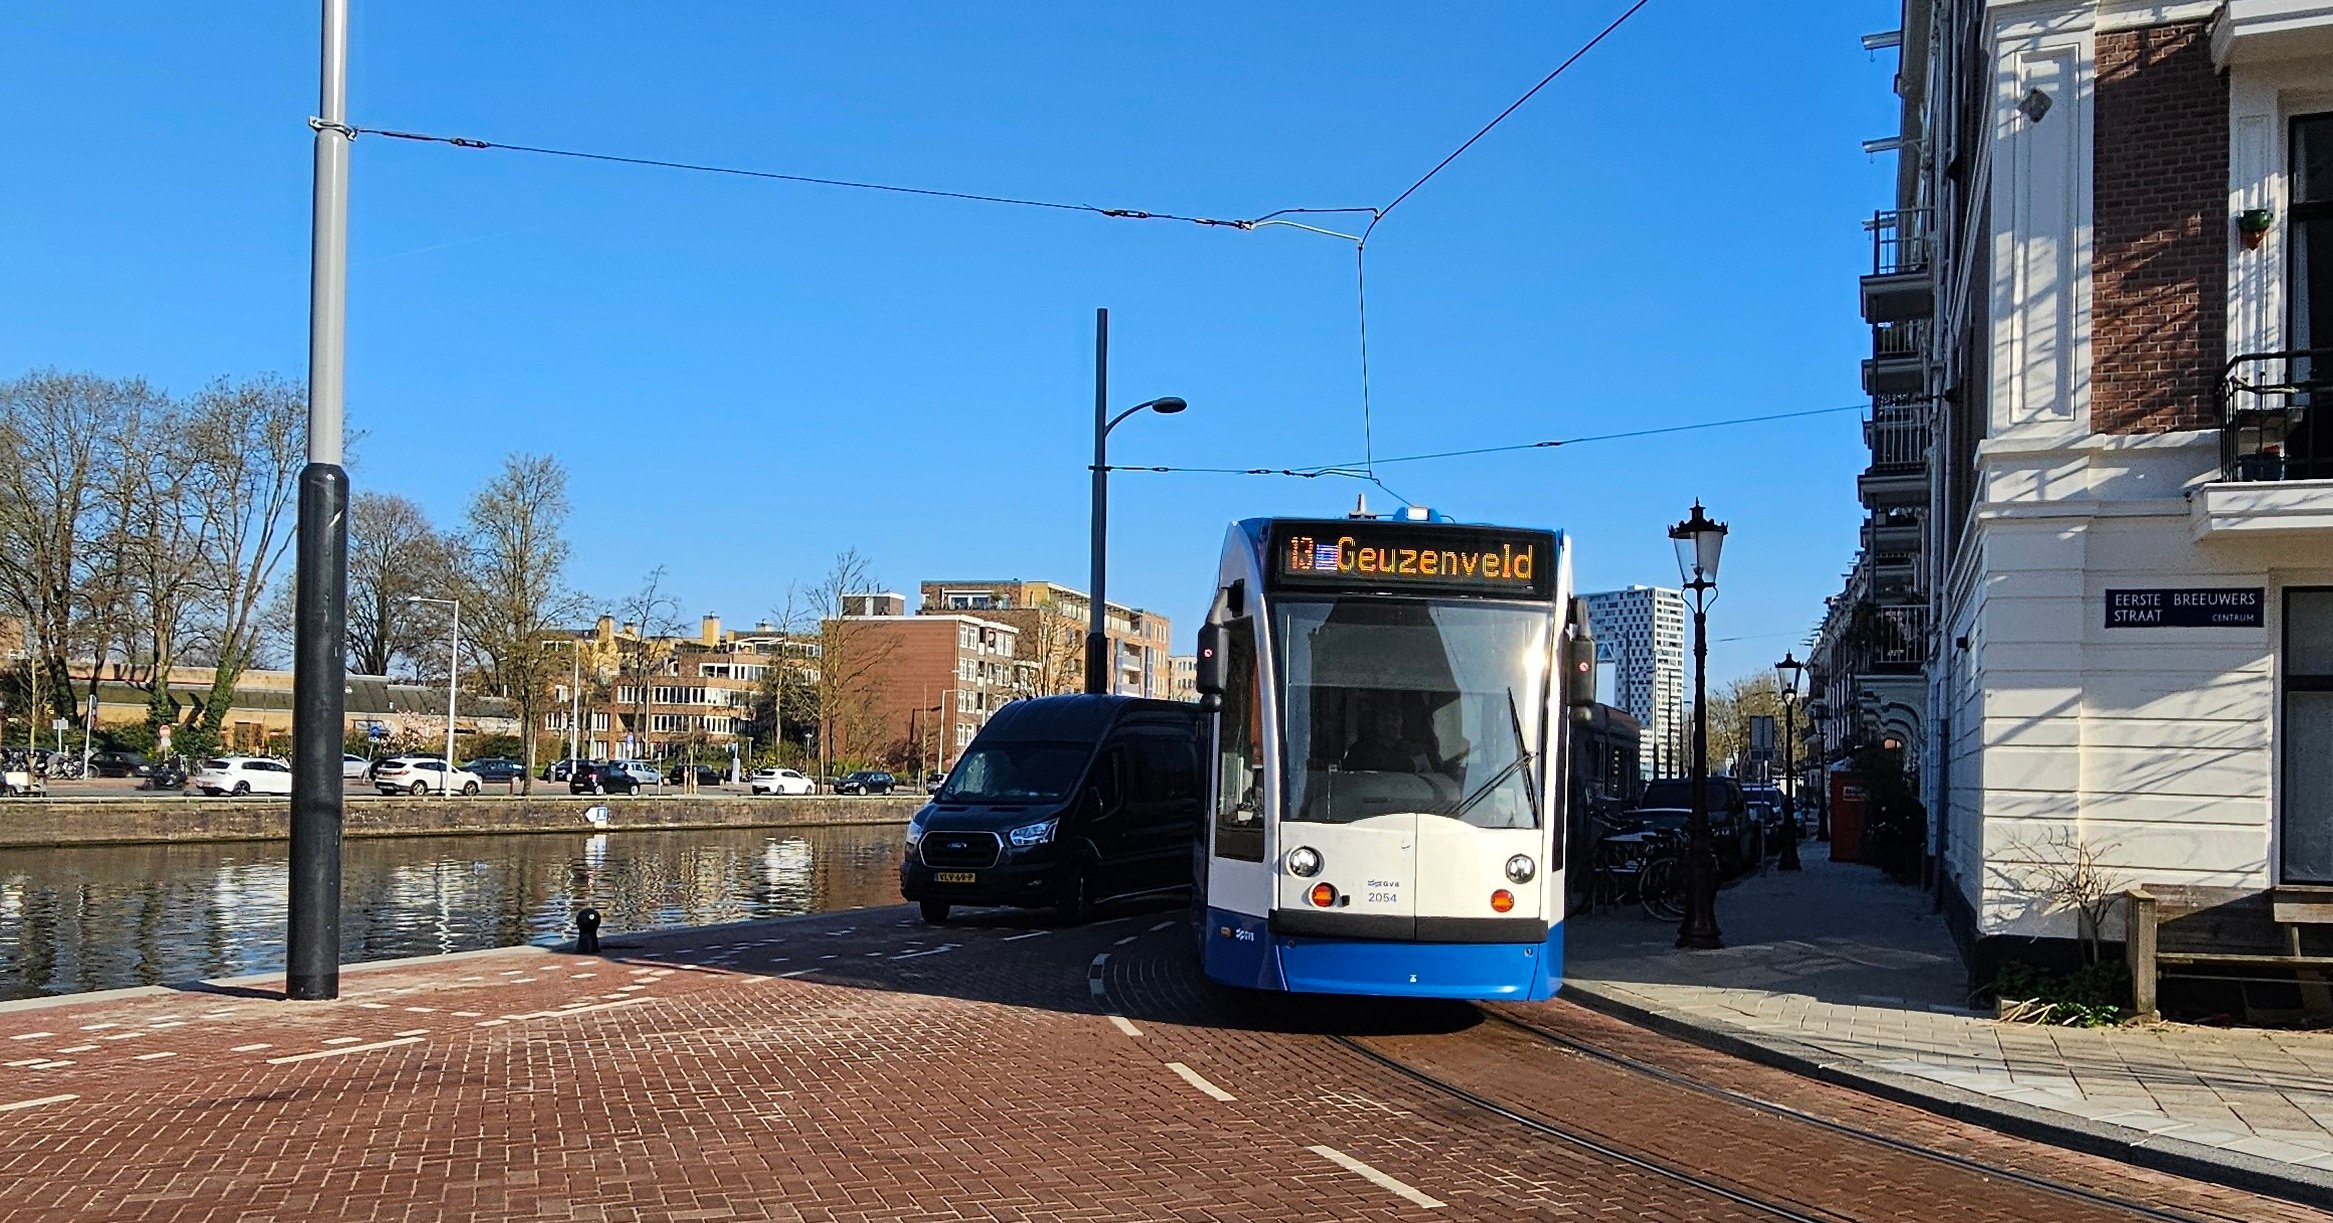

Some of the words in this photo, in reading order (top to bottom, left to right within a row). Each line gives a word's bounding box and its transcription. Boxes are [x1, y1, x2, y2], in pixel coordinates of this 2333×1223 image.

[1337, 536, 1533, 579] Geuzenveld
[2115, 593, 2162, 607] EERSTE
[2173, 592, 2256, 606] BREEUWERS
[2114, 609, 2163, 622] STRAAT
[2212, 613, 2255, 622] CENTRUM
[1368, 892, 1397, 903] 2054
